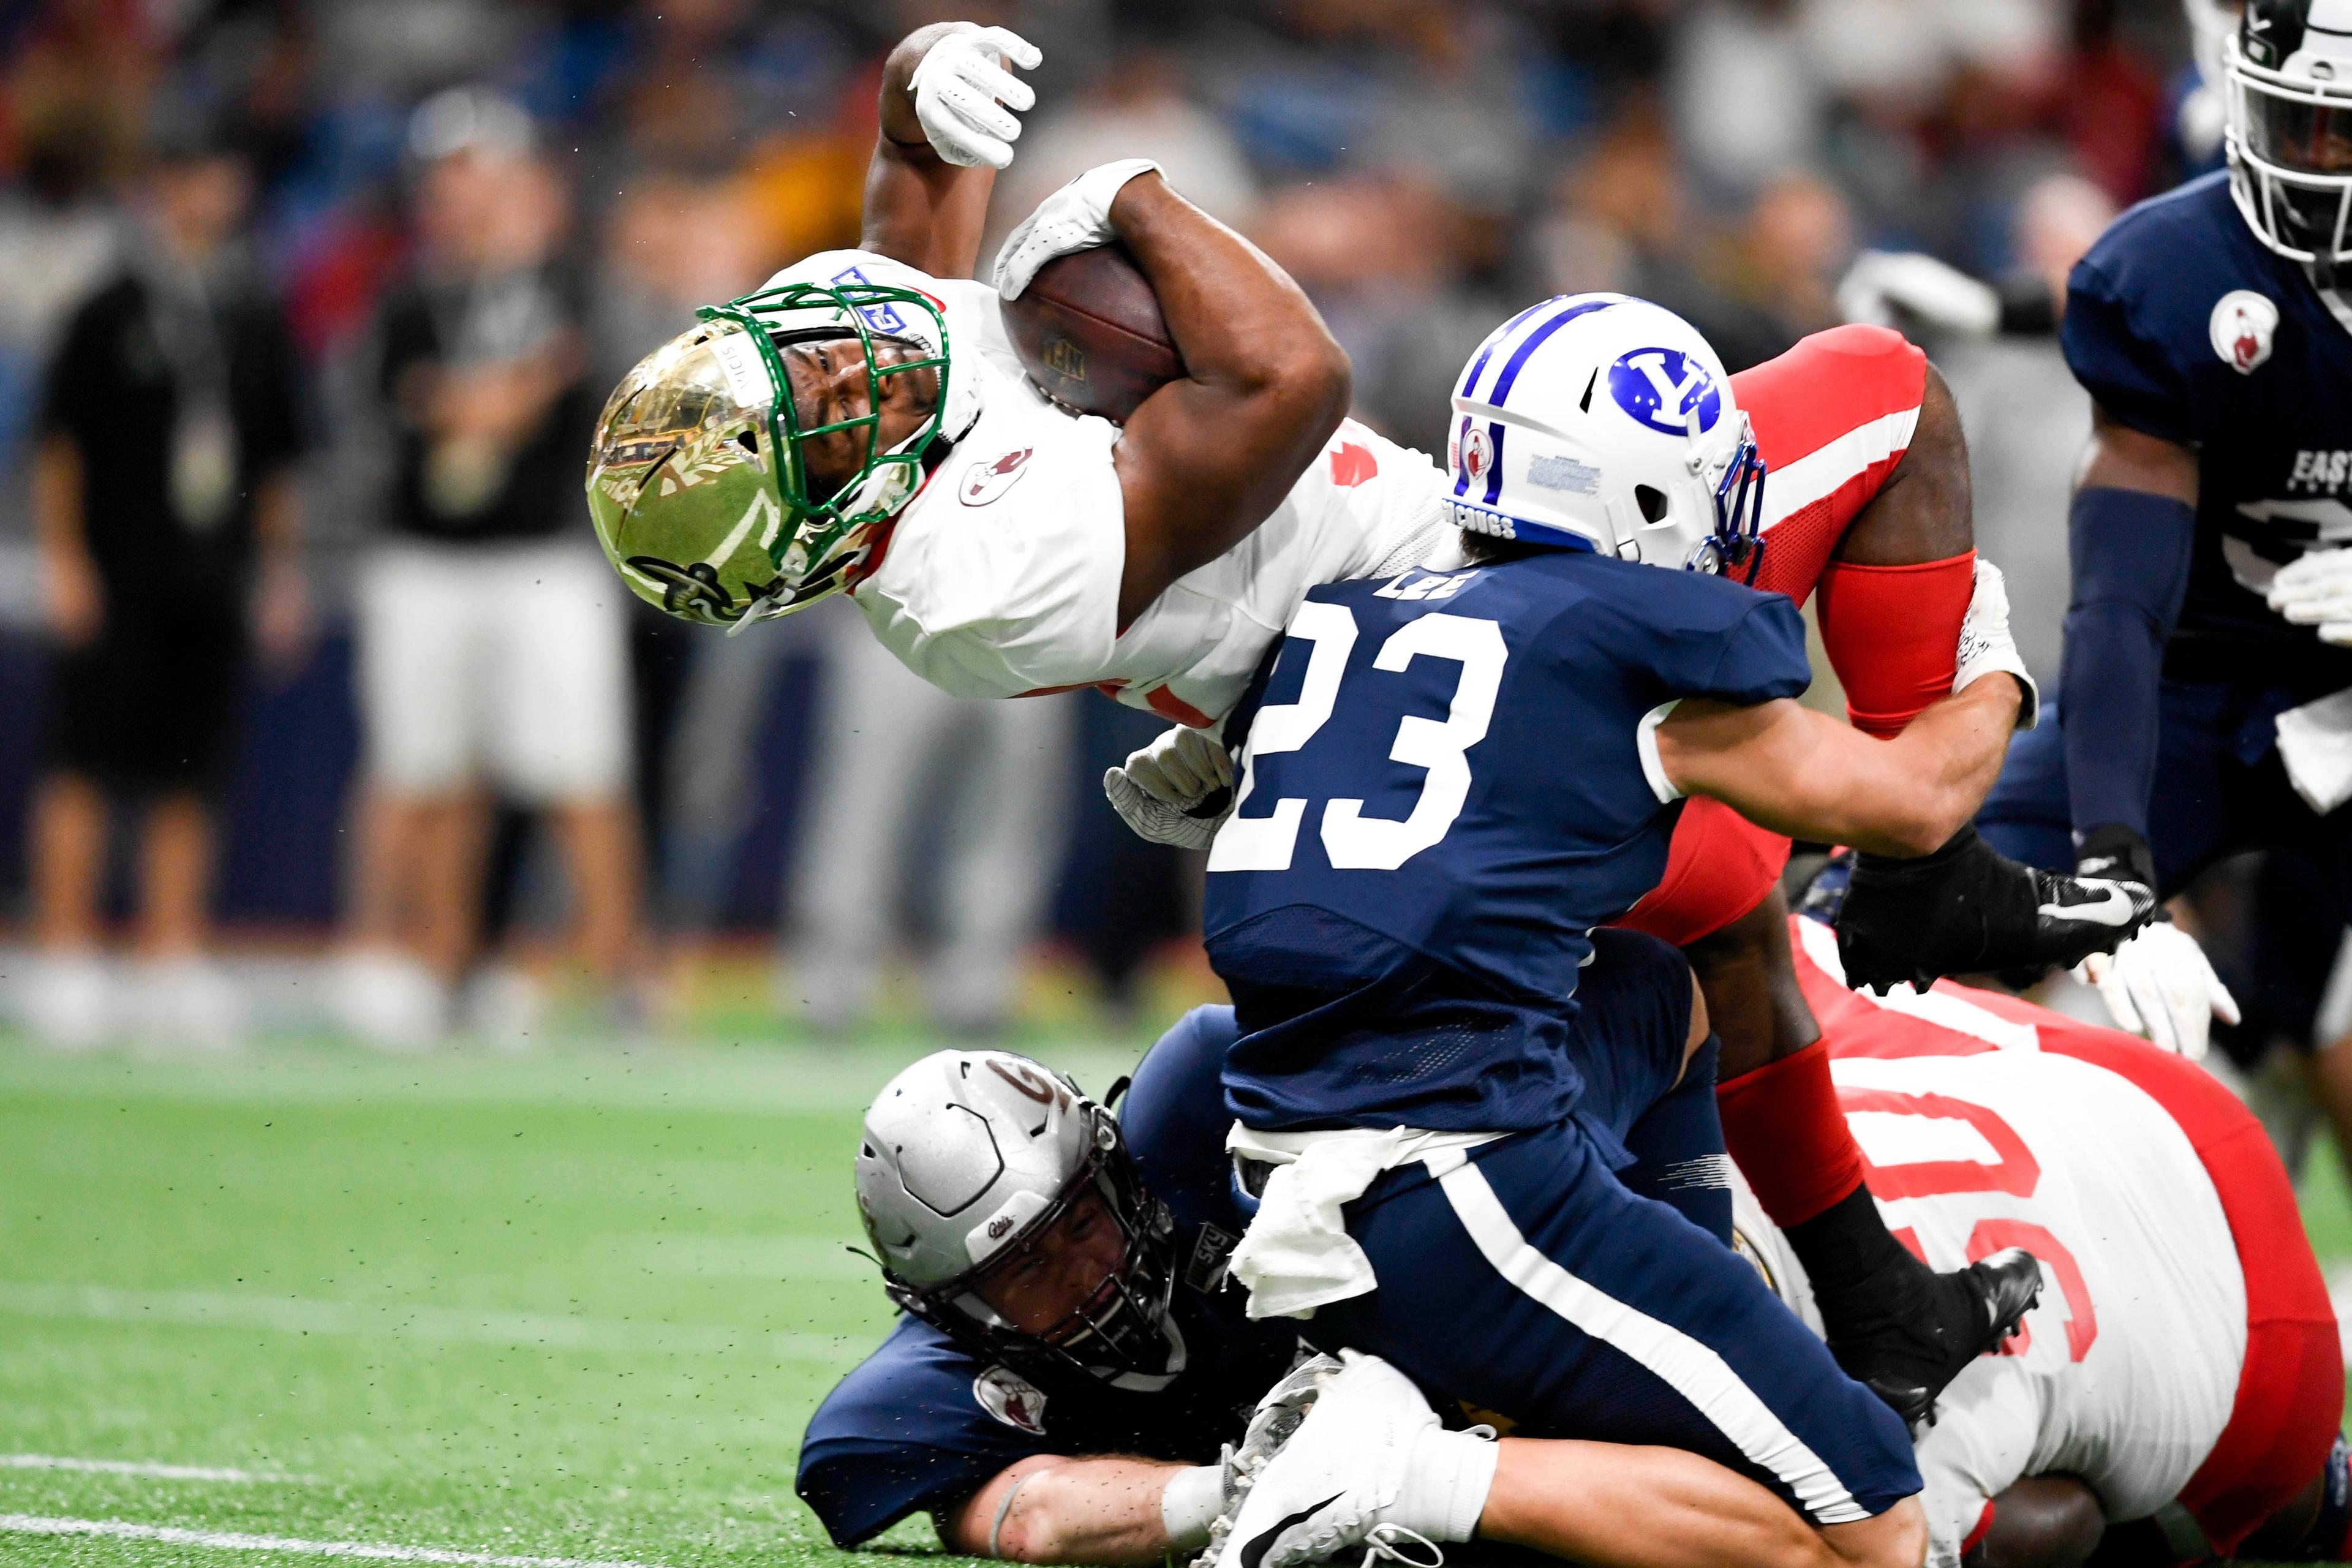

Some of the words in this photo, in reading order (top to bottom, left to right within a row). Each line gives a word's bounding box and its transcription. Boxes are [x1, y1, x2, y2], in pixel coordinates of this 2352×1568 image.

[1627, 352, 1708, 428] Y
[1372, 570, 1480, 600] LEE
[1206, 600, 1509, 872] 23
[1197, 1227, 1229, 1264] SKY
